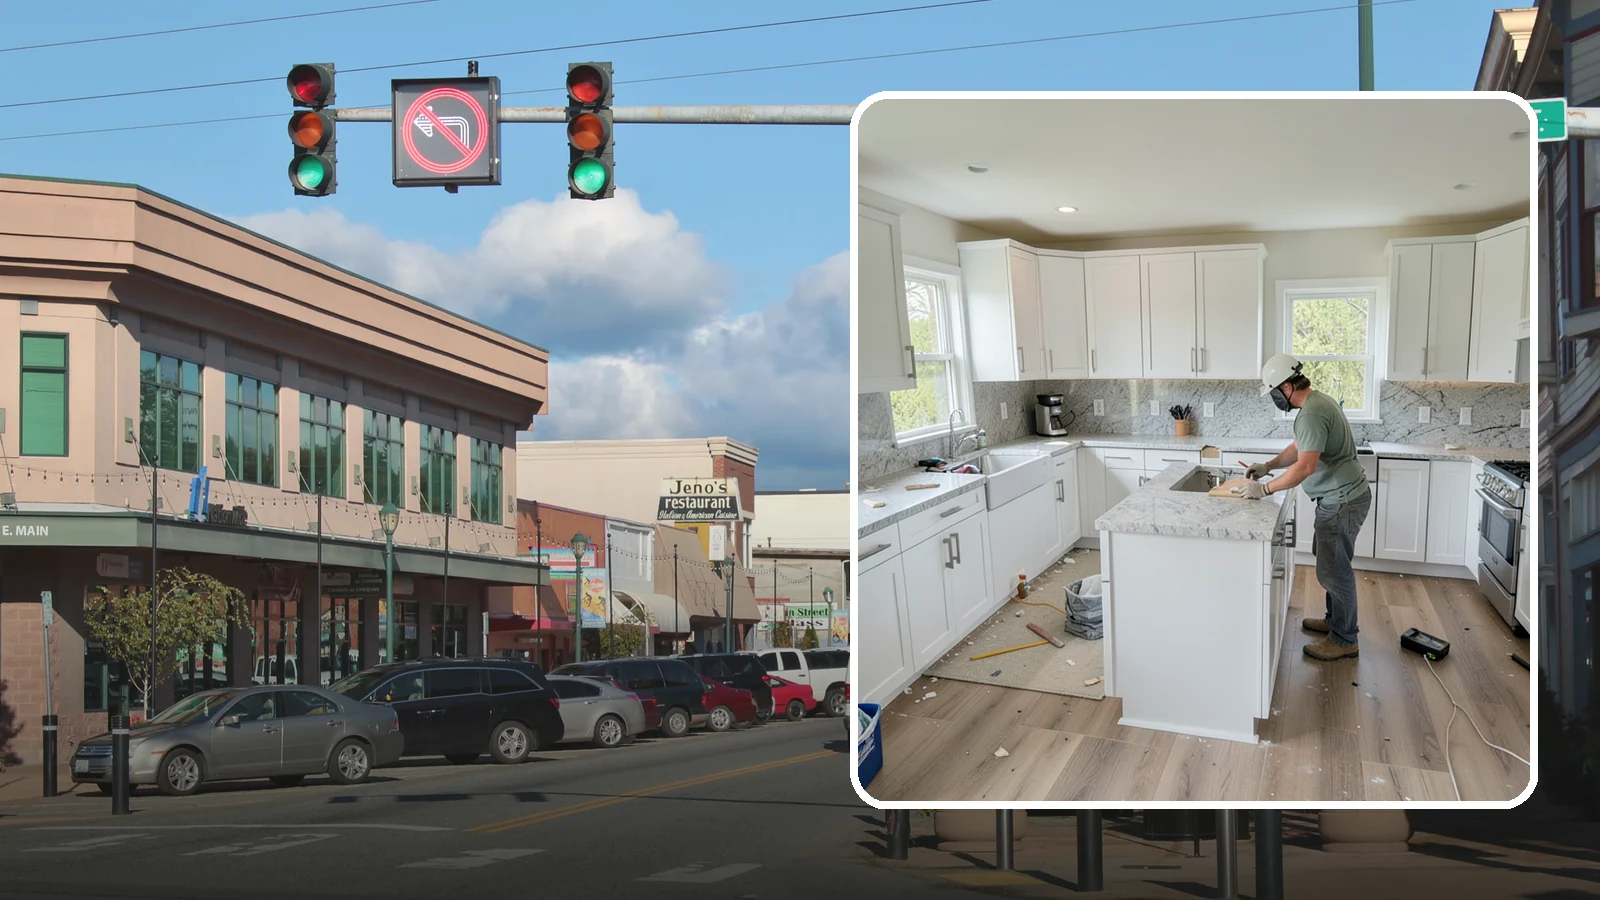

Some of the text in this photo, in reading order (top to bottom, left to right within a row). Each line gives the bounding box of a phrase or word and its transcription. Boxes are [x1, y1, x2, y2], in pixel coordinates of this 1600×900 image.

[670, 480, 727, 494] Jeno's
[665, 496, 730, 509] restaurant
[658, 510, 681, 519] Italian
[686, 510, 714, 519] American
[715, 509, 737, 519] Cuisine
[2, 525, 49, 536] E. MAIN
[797, 607, 828, 616] Street
